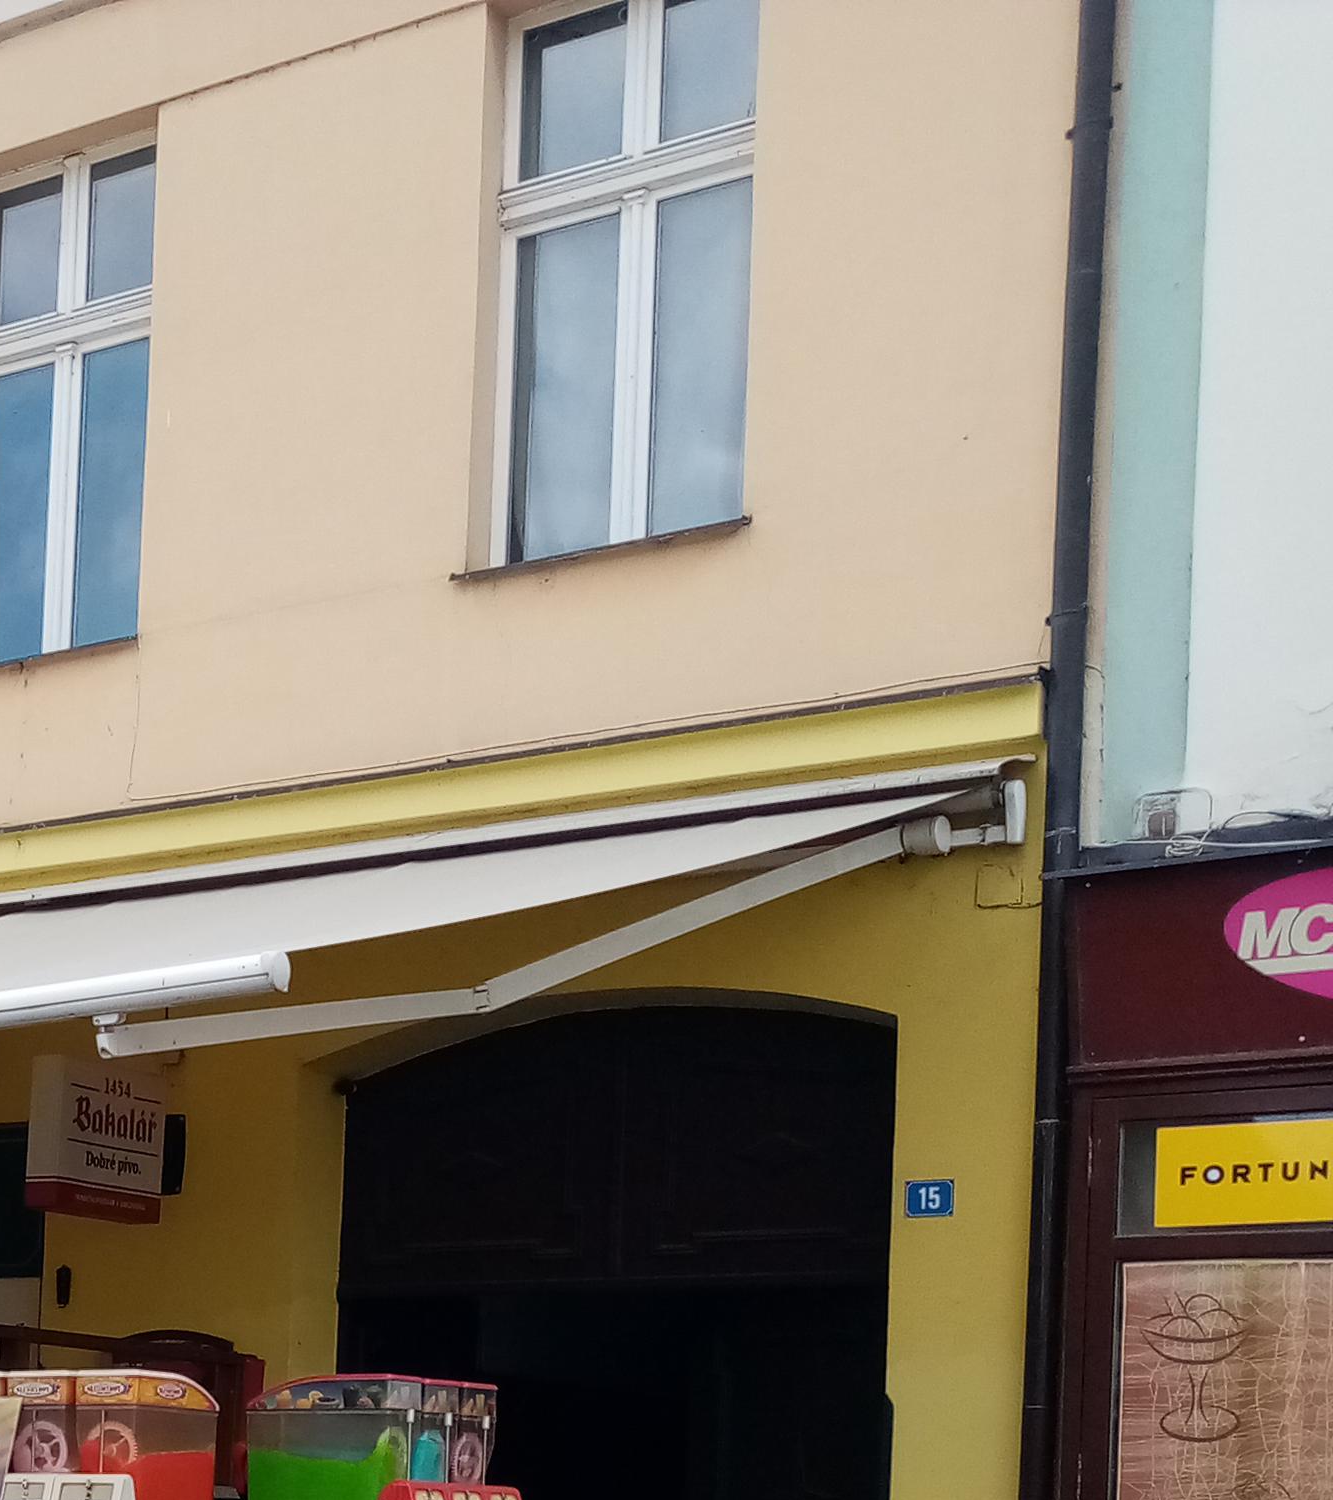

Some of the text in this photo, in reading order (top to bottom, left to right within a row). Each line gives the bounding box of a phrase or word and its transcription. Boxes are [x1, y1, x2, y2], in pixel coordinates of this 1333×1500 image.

[104, 1077, 131, 1098] 1454
[72, 1095, 157, 1144] Bakalář
[85, 1150, 141, 1176] Dobré pivo.
[918, 1187, 941, 1210] 15
